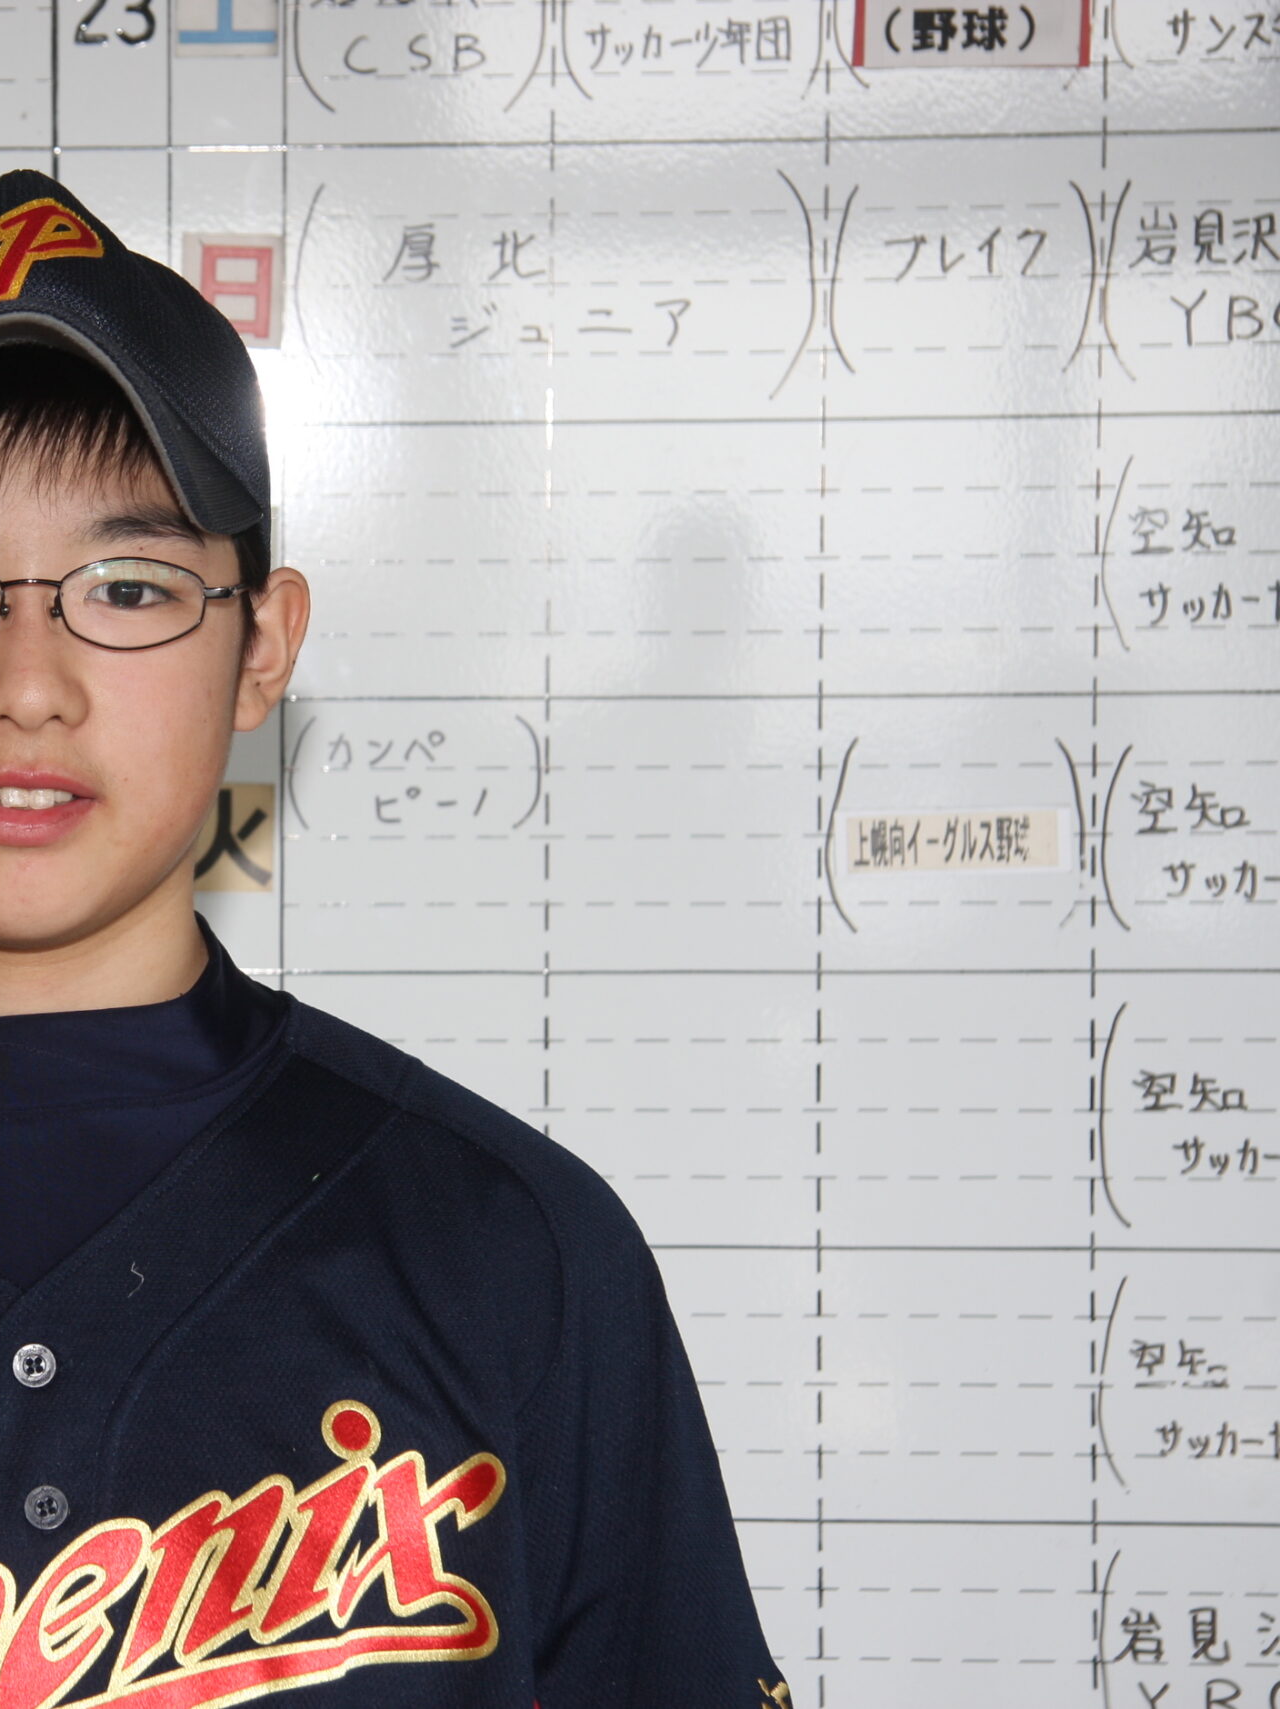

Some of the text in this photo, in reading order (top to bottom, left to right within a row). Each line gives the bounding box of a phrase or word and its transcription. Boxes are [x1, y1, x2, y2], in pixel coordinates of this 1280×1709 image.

[1166, 8, 1280, 54] サンス
[329, 730, 445, 766] カンペ
